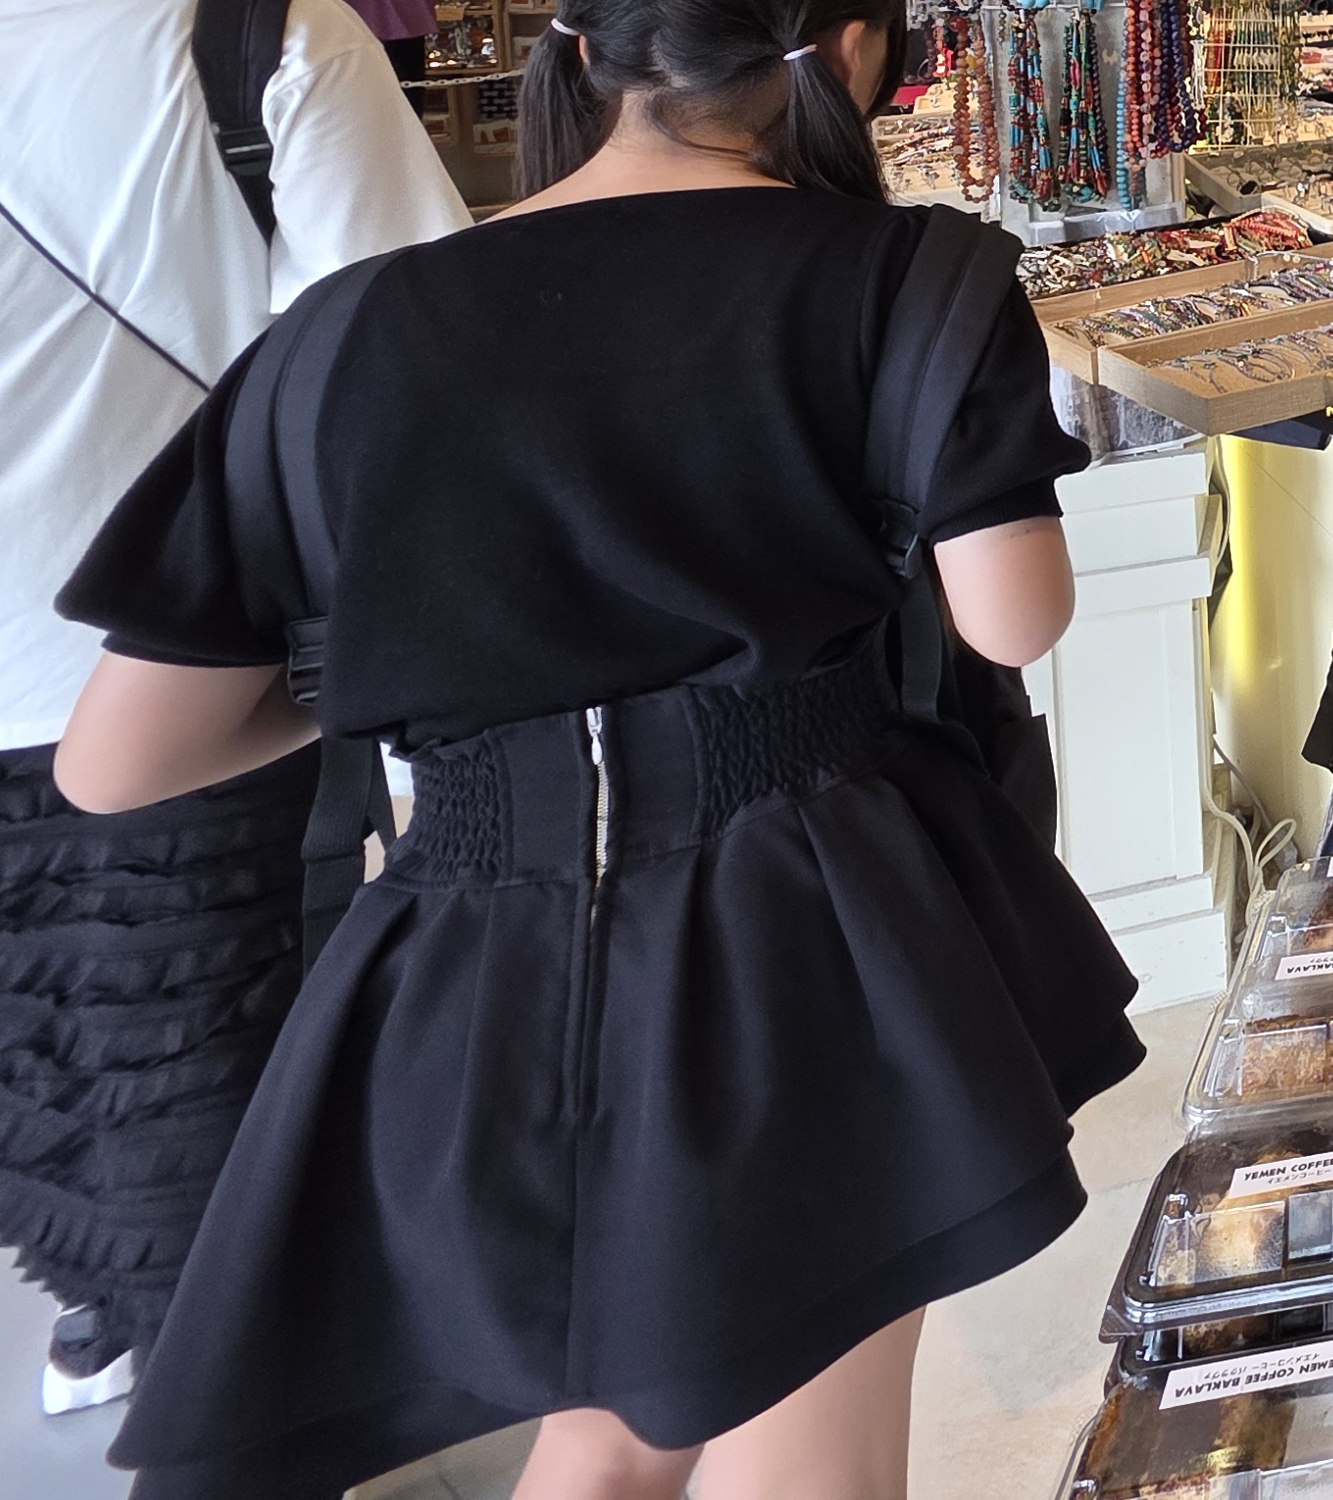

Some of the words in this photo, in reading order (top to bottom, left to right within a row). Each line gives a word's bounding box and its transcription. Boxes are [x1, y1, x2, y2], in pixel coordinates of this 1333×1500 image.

[1243, 1166, 1287, 1182] YEMEN
[1244, 1367, 1295, 1385] COFFEE
[1174, 1377, 1241, 1399] BAKLAVA
